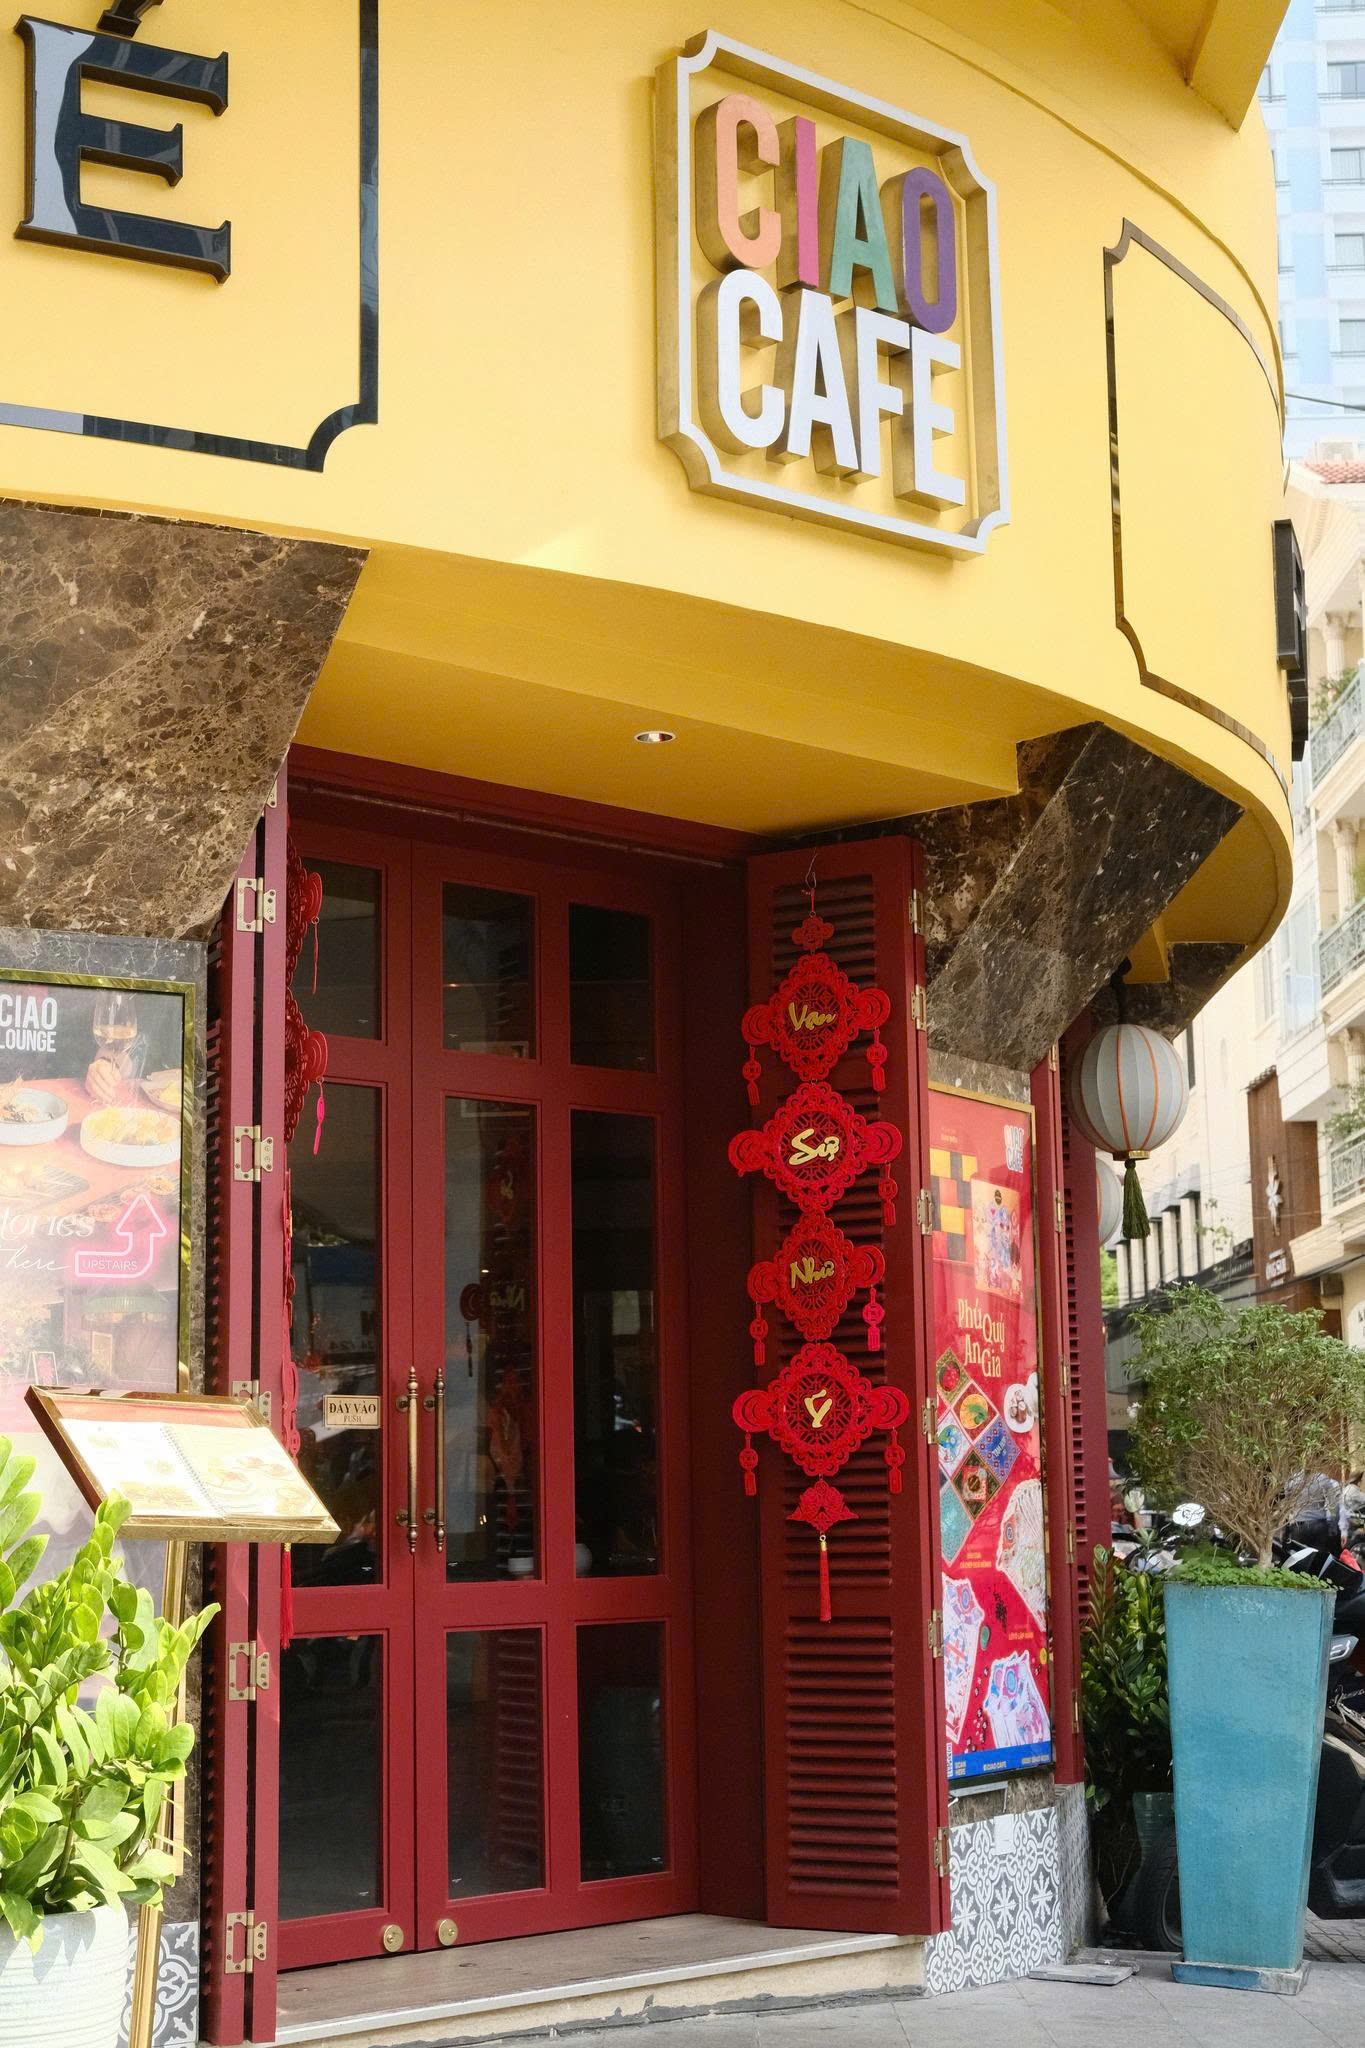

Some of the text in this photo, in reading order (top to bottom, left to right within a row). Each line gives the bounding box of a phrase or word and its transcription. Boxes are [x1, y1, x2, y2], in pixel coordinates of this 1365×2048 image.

[696, 94, 957, 333] CIAO
[696, 268, 966, 512] CAFE
[0, 994, 58, 1030] CIAO
[82, 1260, 138, 1271] UPSTAIRS
[958, 1297, 1006, 1353] Phú Quý
[964, 1333, 1002, 1378] An Gia
[343, 1415, 362, 1423] PUSH
